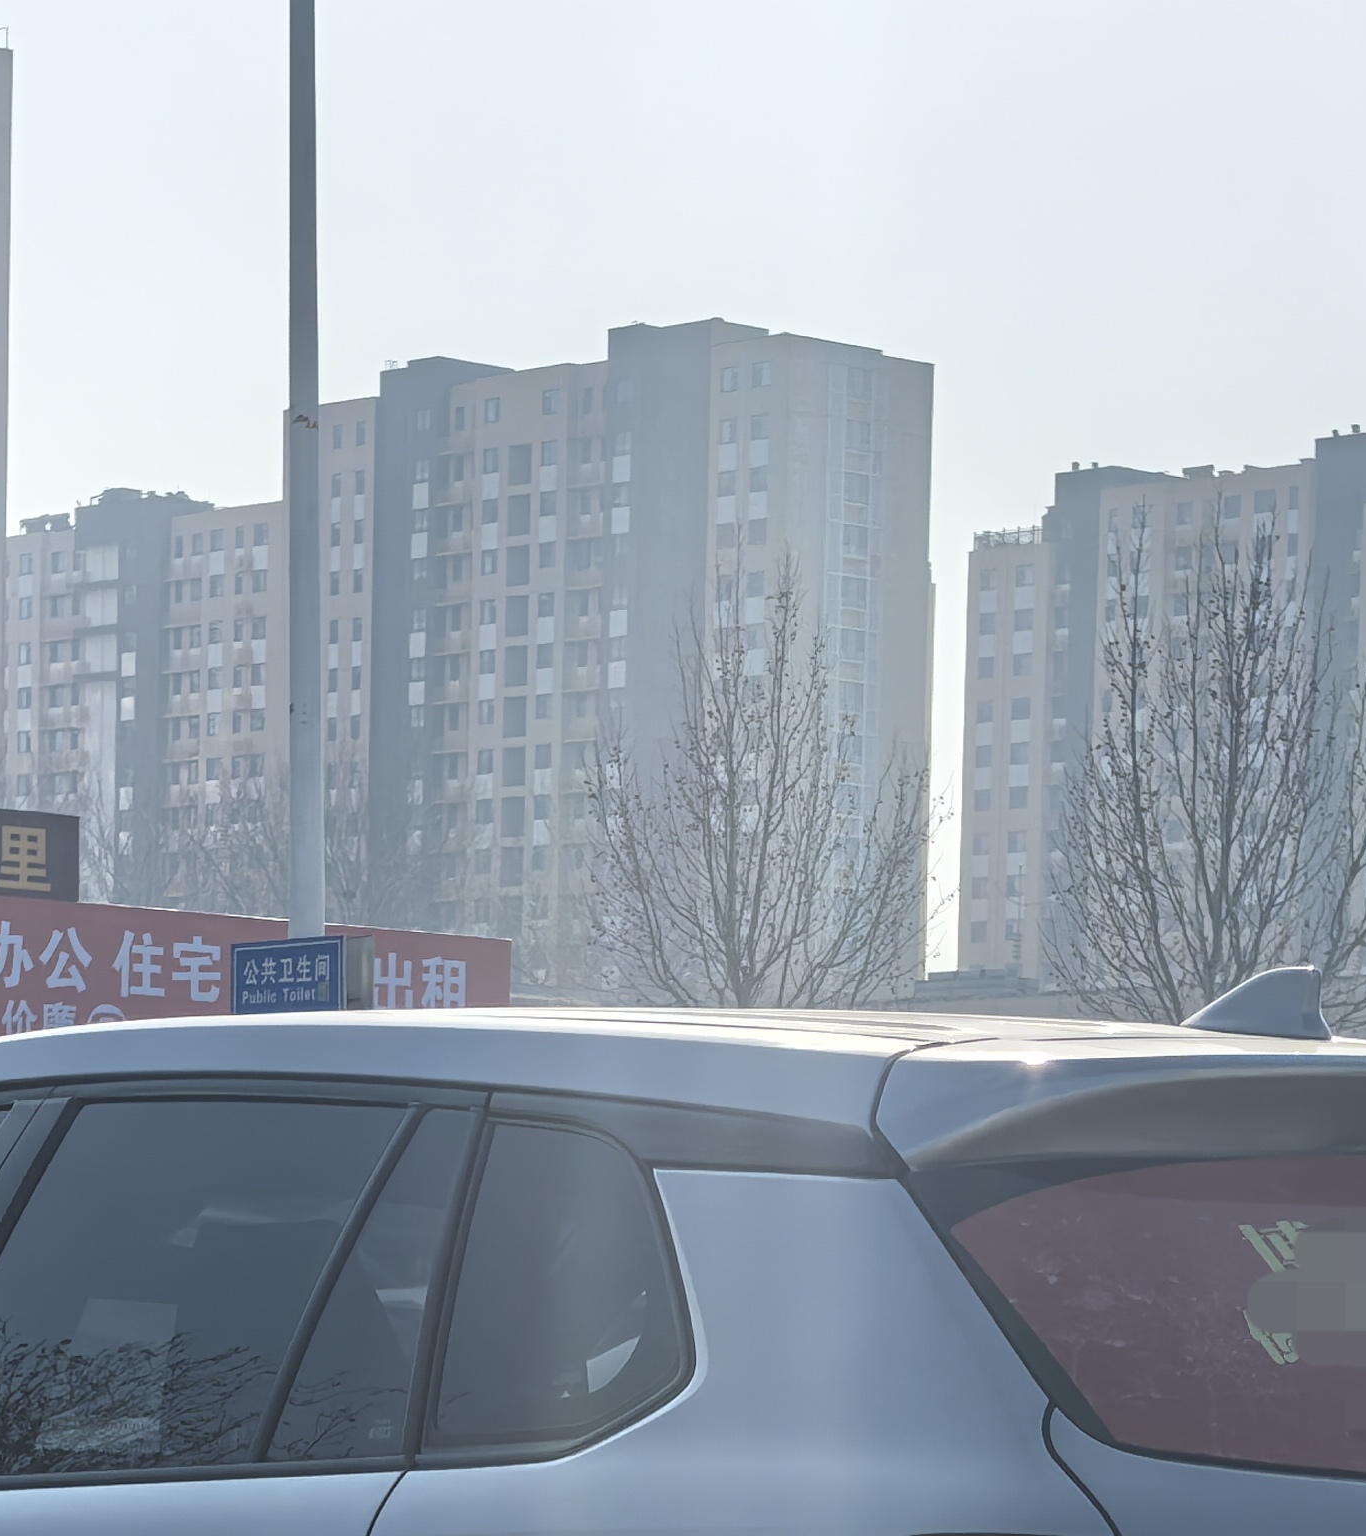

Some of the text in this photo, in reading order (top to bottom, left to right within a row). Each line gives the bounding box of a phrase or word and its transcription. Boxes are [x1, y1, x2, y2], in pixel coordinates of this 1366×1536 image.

[113, 930, 223, 1003] 住宅
[373, 954, 469, 1009] 出租
[243, 954, 330, 985] 公共卫生间
[242, 986, 316, 1005] Public Toilet
